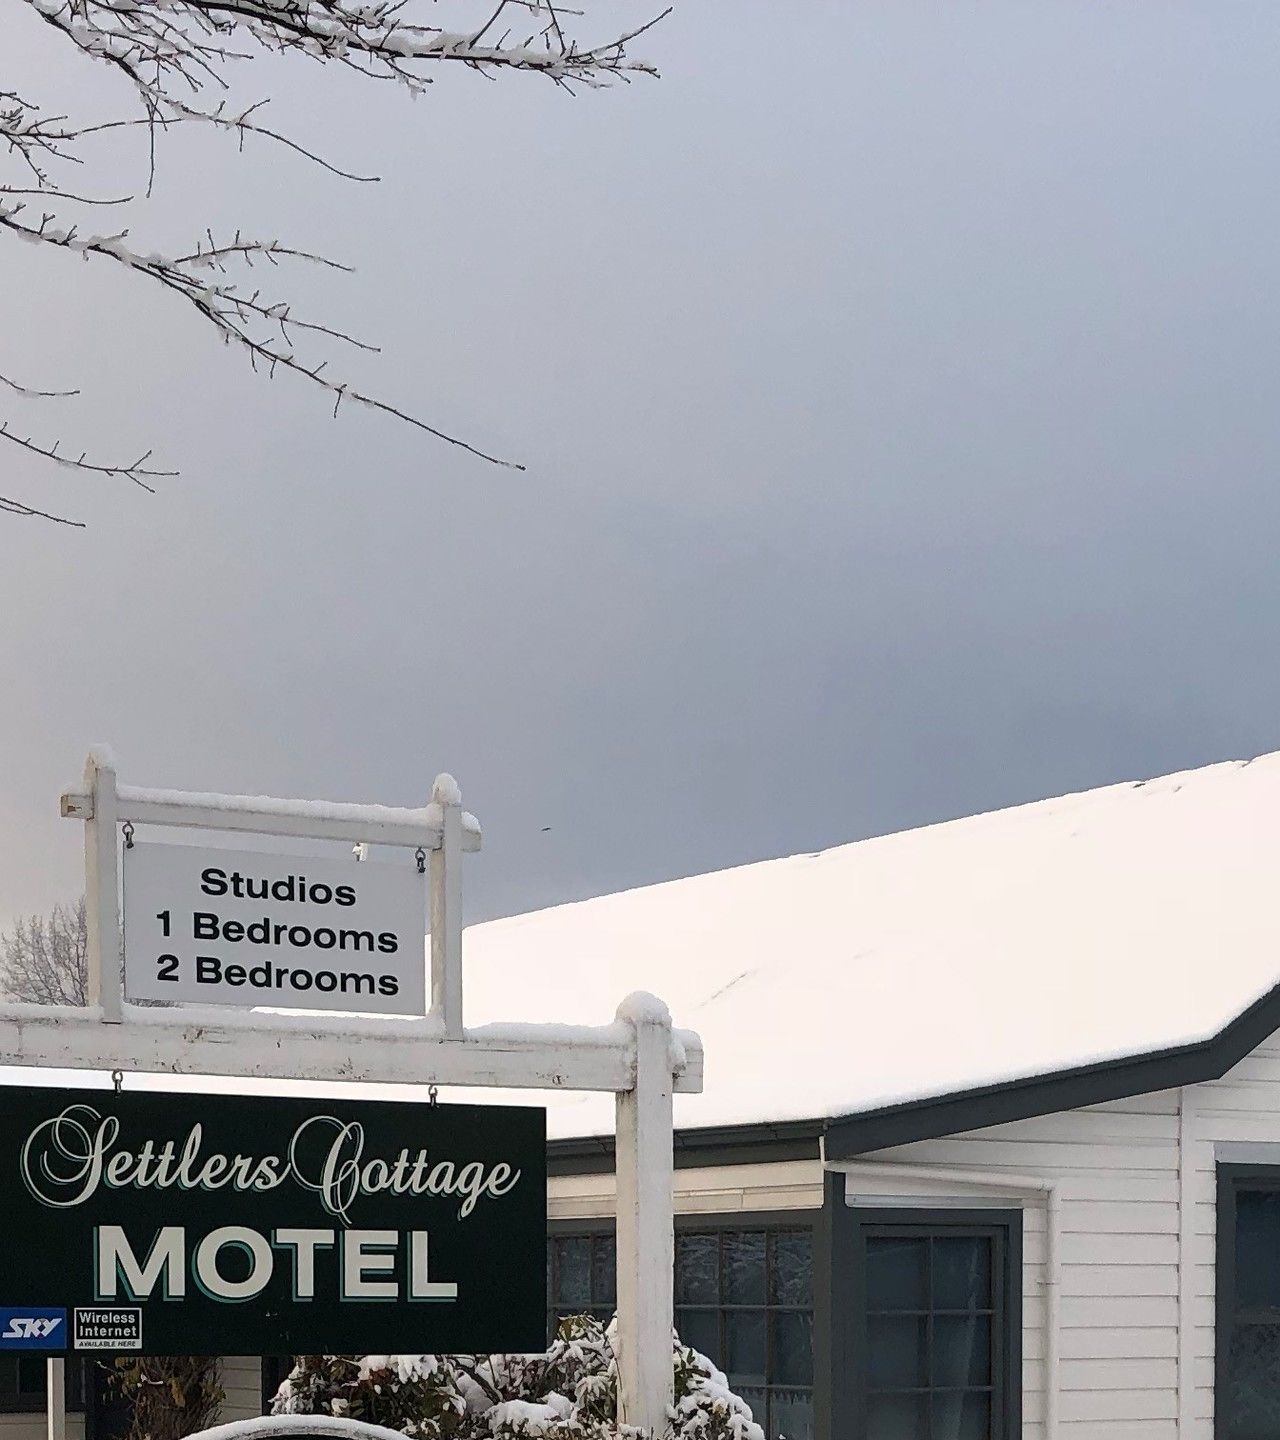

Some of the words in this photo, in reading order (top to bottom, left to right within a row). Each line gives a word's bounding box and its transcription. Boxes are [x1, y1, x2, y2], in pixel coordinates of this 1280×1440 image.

[200, 867, 357, 907] Studios
[156, 909, 171, 937] 1
[193, 911, 399, 954] Bedrooms
[156, 954, 179, 982] 2
[196, 956, 400, 996] Bedrooms
[22, 1103, 293, 1208] Settlers
[290, 1114, 521, 1225] Cottage
[94, 1224, 458, 1302] MOTEL
[2, 1318, 63, 1338] SKY
[78, 1311, 136, 1324] Wireless
[79, 1325, 137, 1337] Internet
